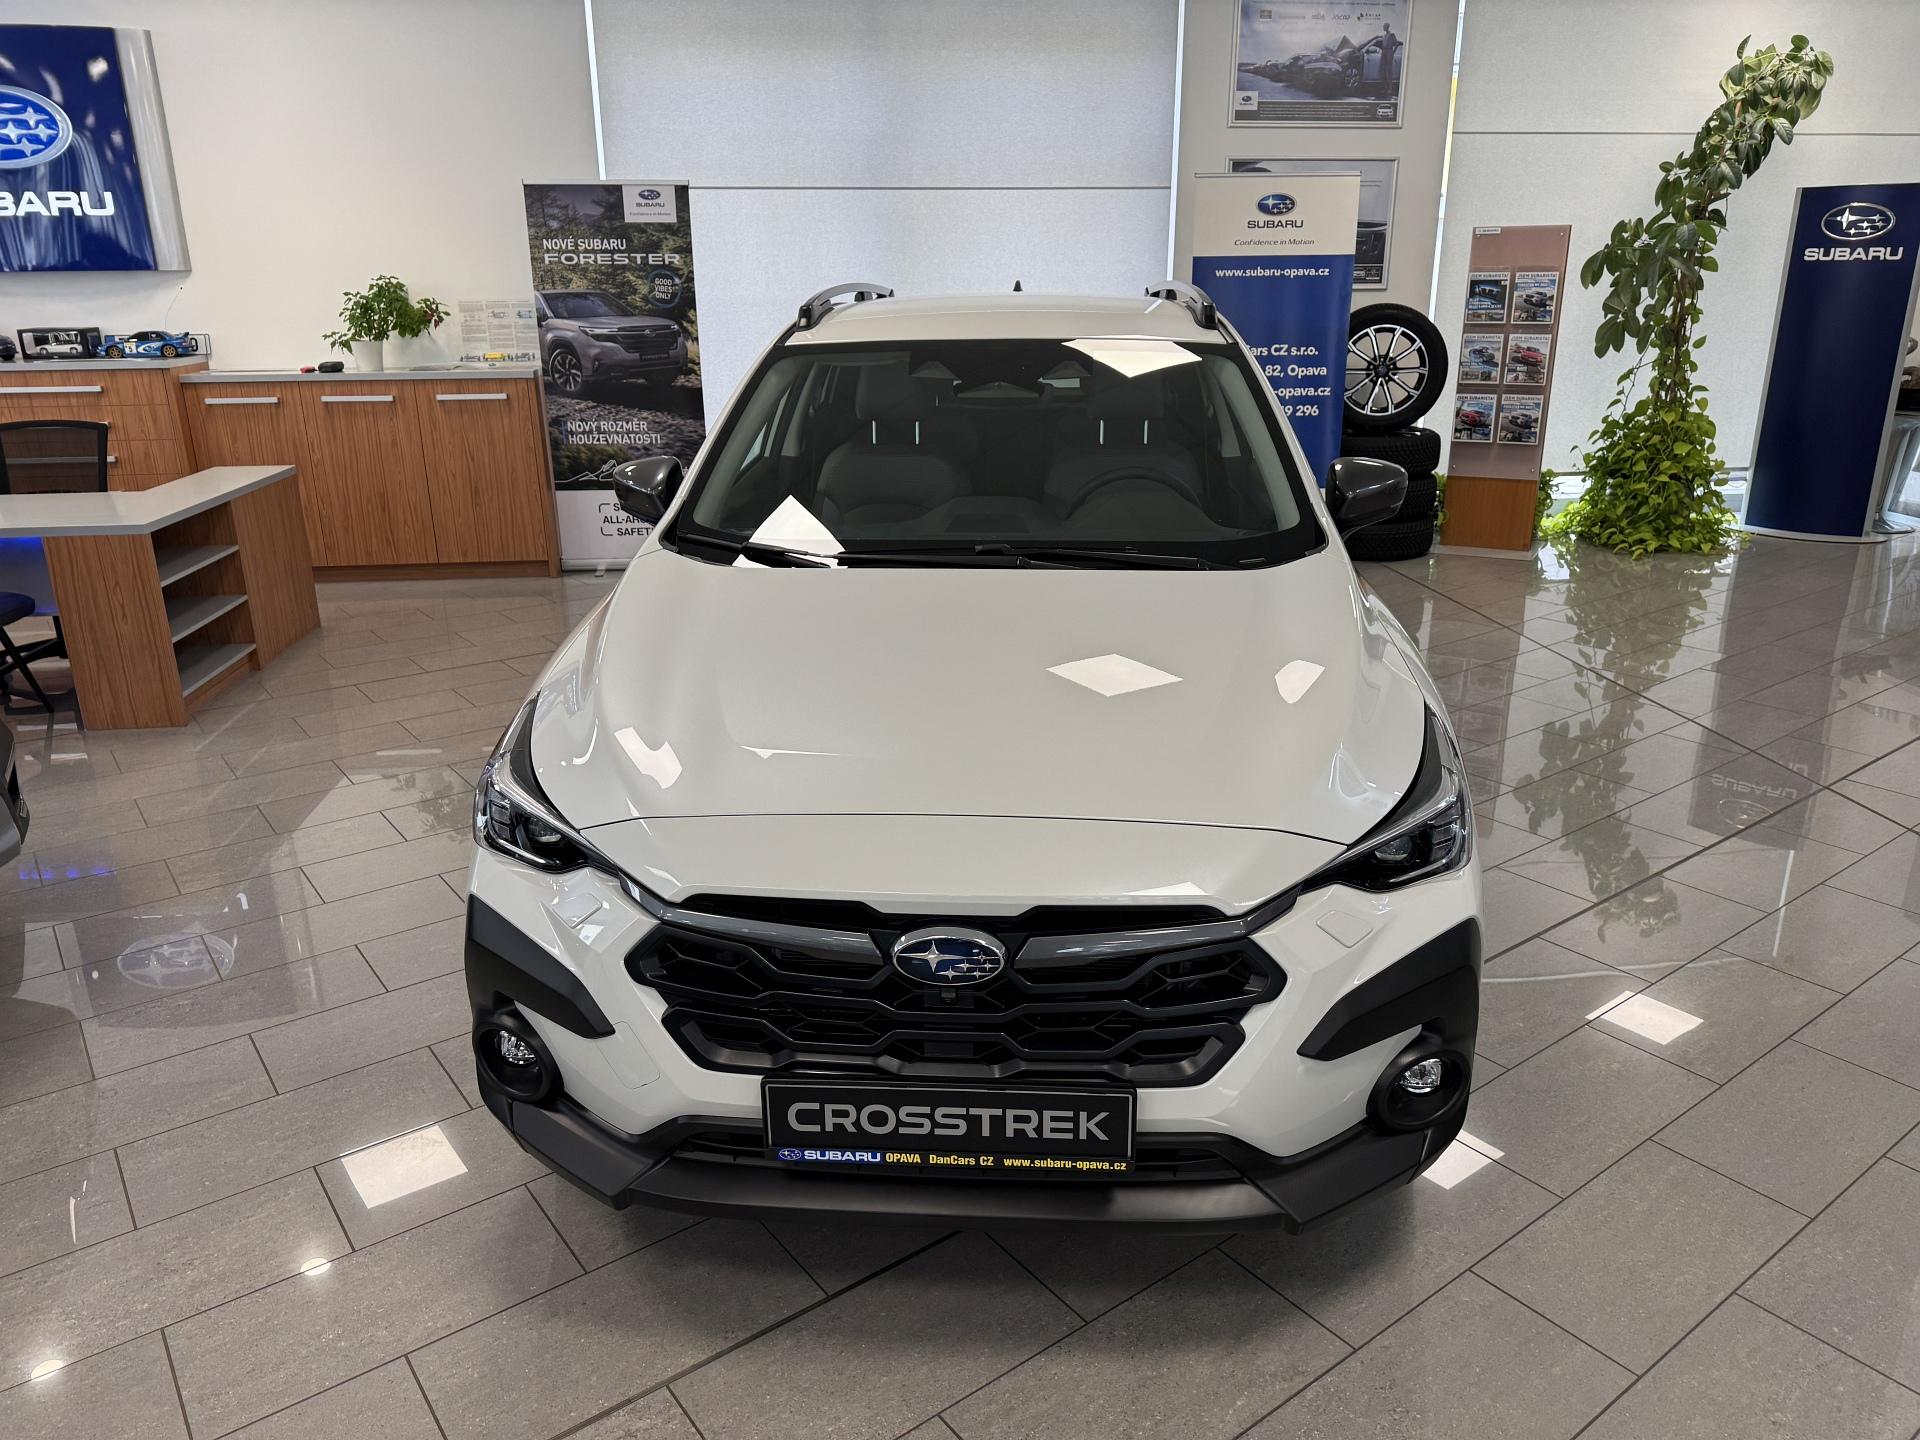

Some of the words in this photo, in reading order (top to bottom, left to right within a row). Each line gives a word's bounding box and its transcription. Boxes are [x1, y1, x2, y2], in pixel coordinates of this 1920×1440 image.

[1247, 219, 1304, 229] SUBARU
[542, 236, 575, 250] NOVÉ
[577, 238, 627, 250] SUBARU
[1288, 238, 1315, 246] Motion
[544, 253, 681, 265] FORESTER
[1803, 247, 1904, 261] SUBARU
[1215, 267, 1330, 278] www.subaru-opava.cz
[654, 278, 673, 286] GOOD
[654, 285, 673, 293] VIBES
[655, 292, 671, 300] ONLY
[1270, 344, 1289, 356] CZ
[1290, 346, 1319, 355] s.r.o.
[1265, 364, 1284, 378] 82,
[1287, 364, 1327, 379] Opava
[1273, 387, 1331, 399] -opava.cz
[1295, 405, 1319, 416] 296
[567, 418, 597, 432] NOVÝ
[600, 420, 648, 432] ROZMĚR
[569, 431, 661, 445] HOUŽEVNATOSTI
[787, 1102, 1110, 1141] CROSSTREK
[803, 1150, 881, 1162] SUBARU
[885, 1153, 922, 1164] OPAVA
[929, 1154, 976, 1166] DanCars
[979, 1155, 994, 1166] CZ
[1003, 1156, 1127, 1171] www.subaru-opava.cz
